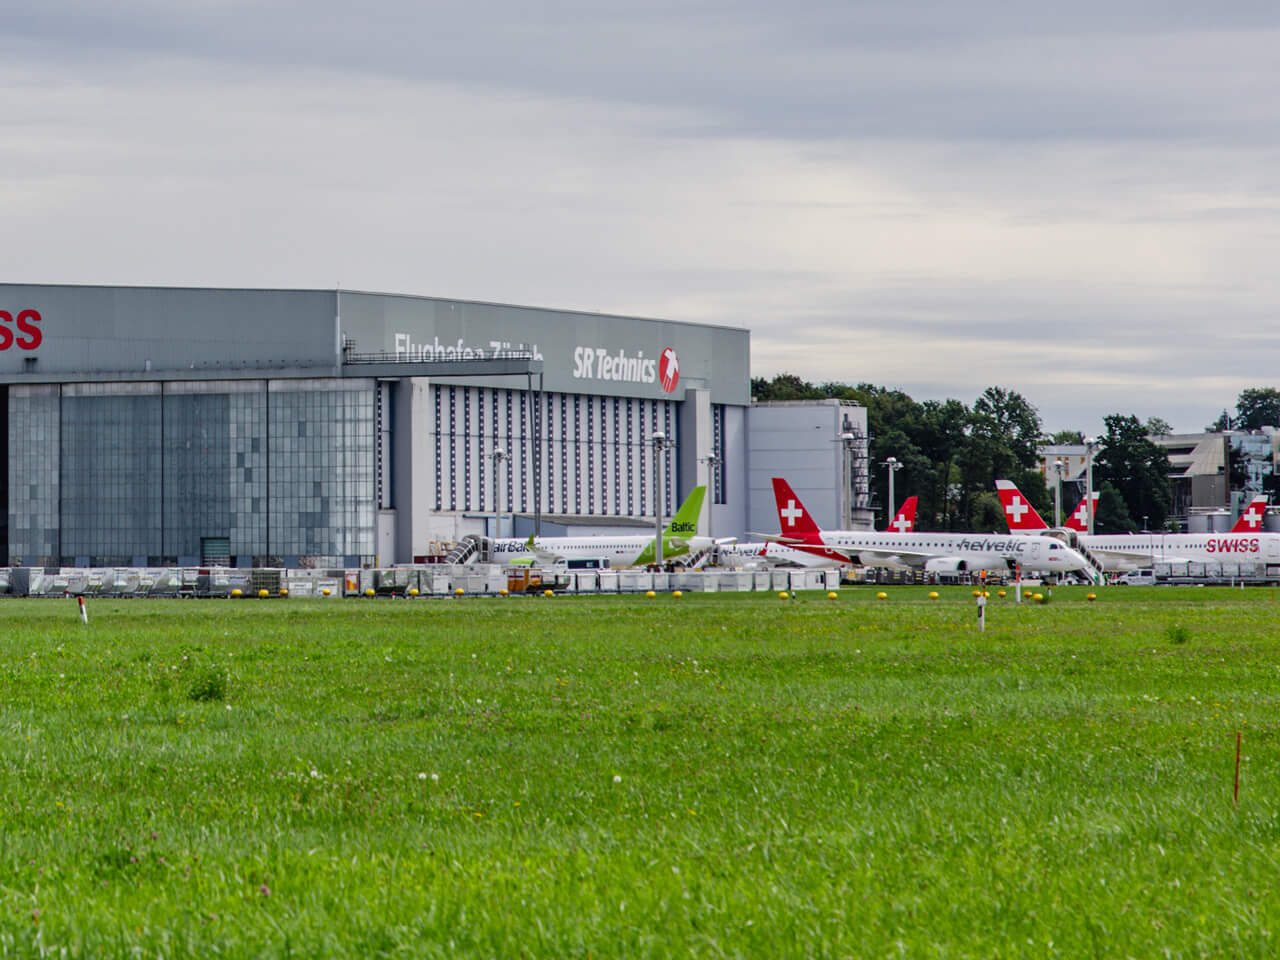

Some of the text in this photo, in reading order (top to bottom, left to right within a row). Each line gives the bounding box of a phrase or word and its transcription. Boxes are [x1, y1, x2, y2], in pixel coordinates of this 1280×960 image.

[573, 346, 656, 383] SR Technics
[671, 522, 695, 533] Baltic
[957, 539, 1026, 552] helvetic
[1206, 538, 1260, 553] SWISS
